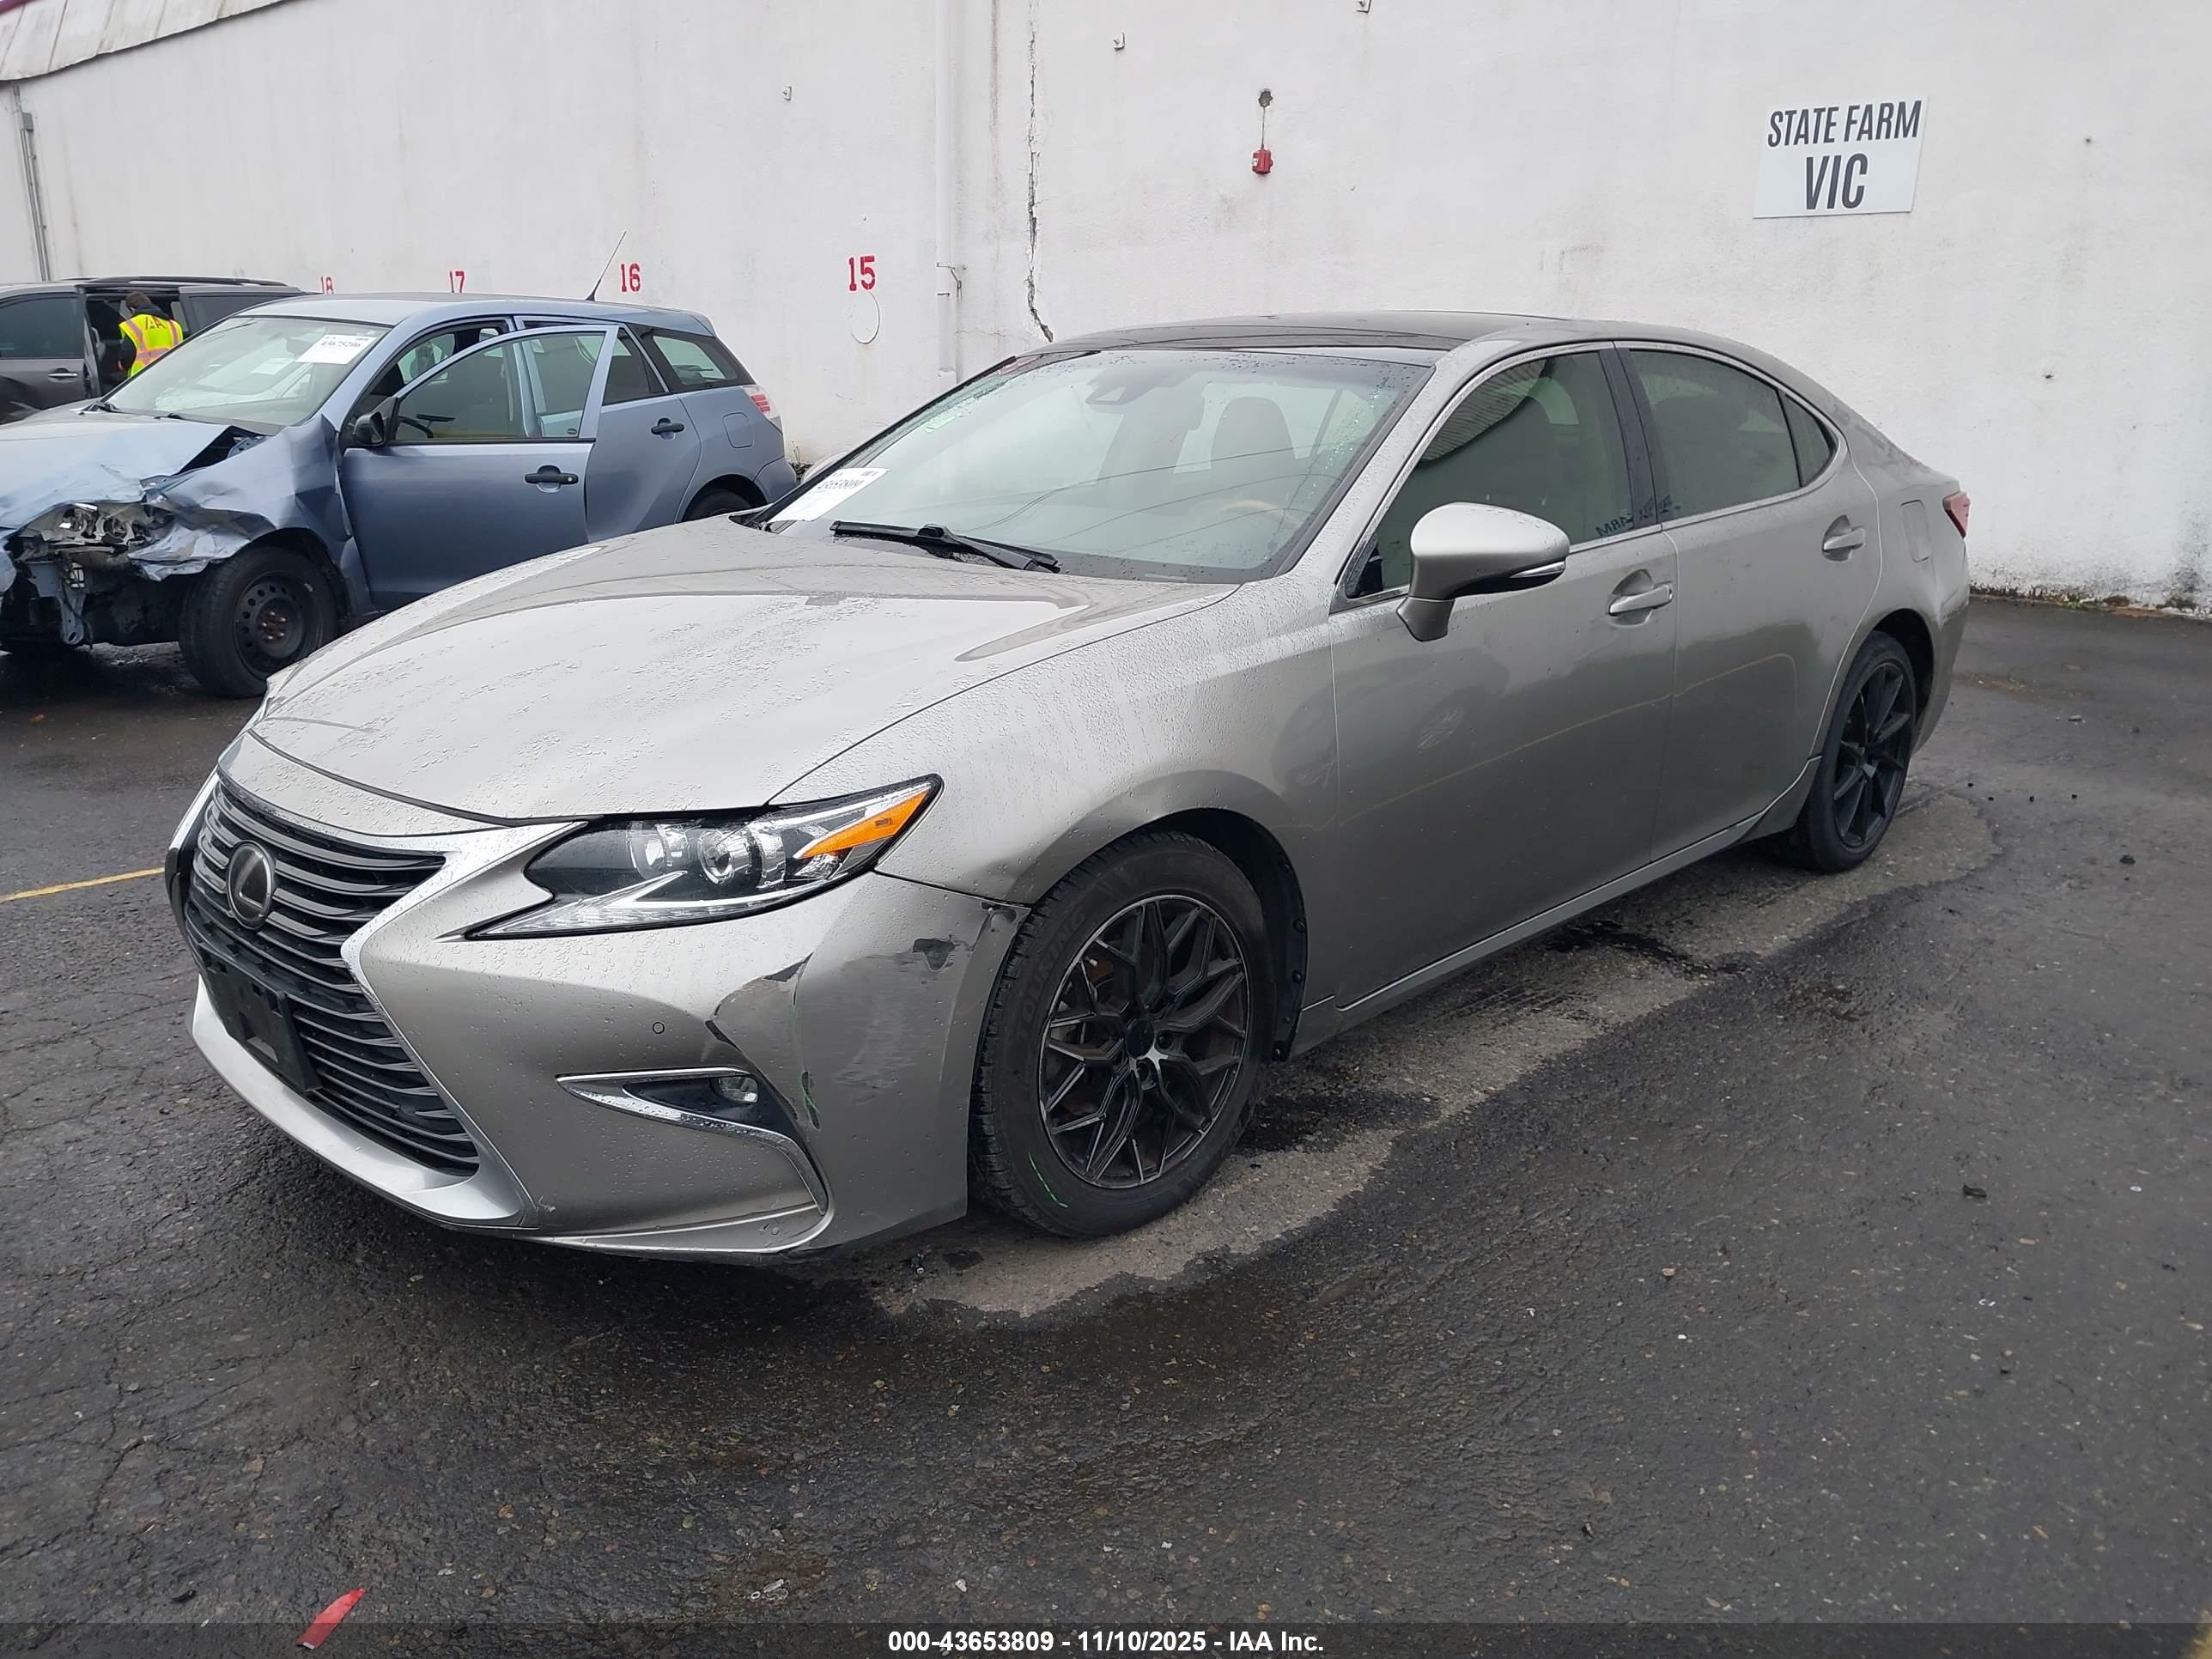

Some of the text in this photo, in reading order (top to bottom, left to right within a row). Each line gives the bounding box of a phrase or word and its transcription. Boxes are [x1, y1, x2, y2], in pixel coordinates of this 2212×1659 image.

[1767, 100, 1922, 148] STATE FARM
[1806, 153, 1869, 210] VIC
[320, 276, 334, 295] 18
[449, 270, 466, 294] 17
[620, 263, 641, 293] 16
[848, 254, 877, 292] 15
